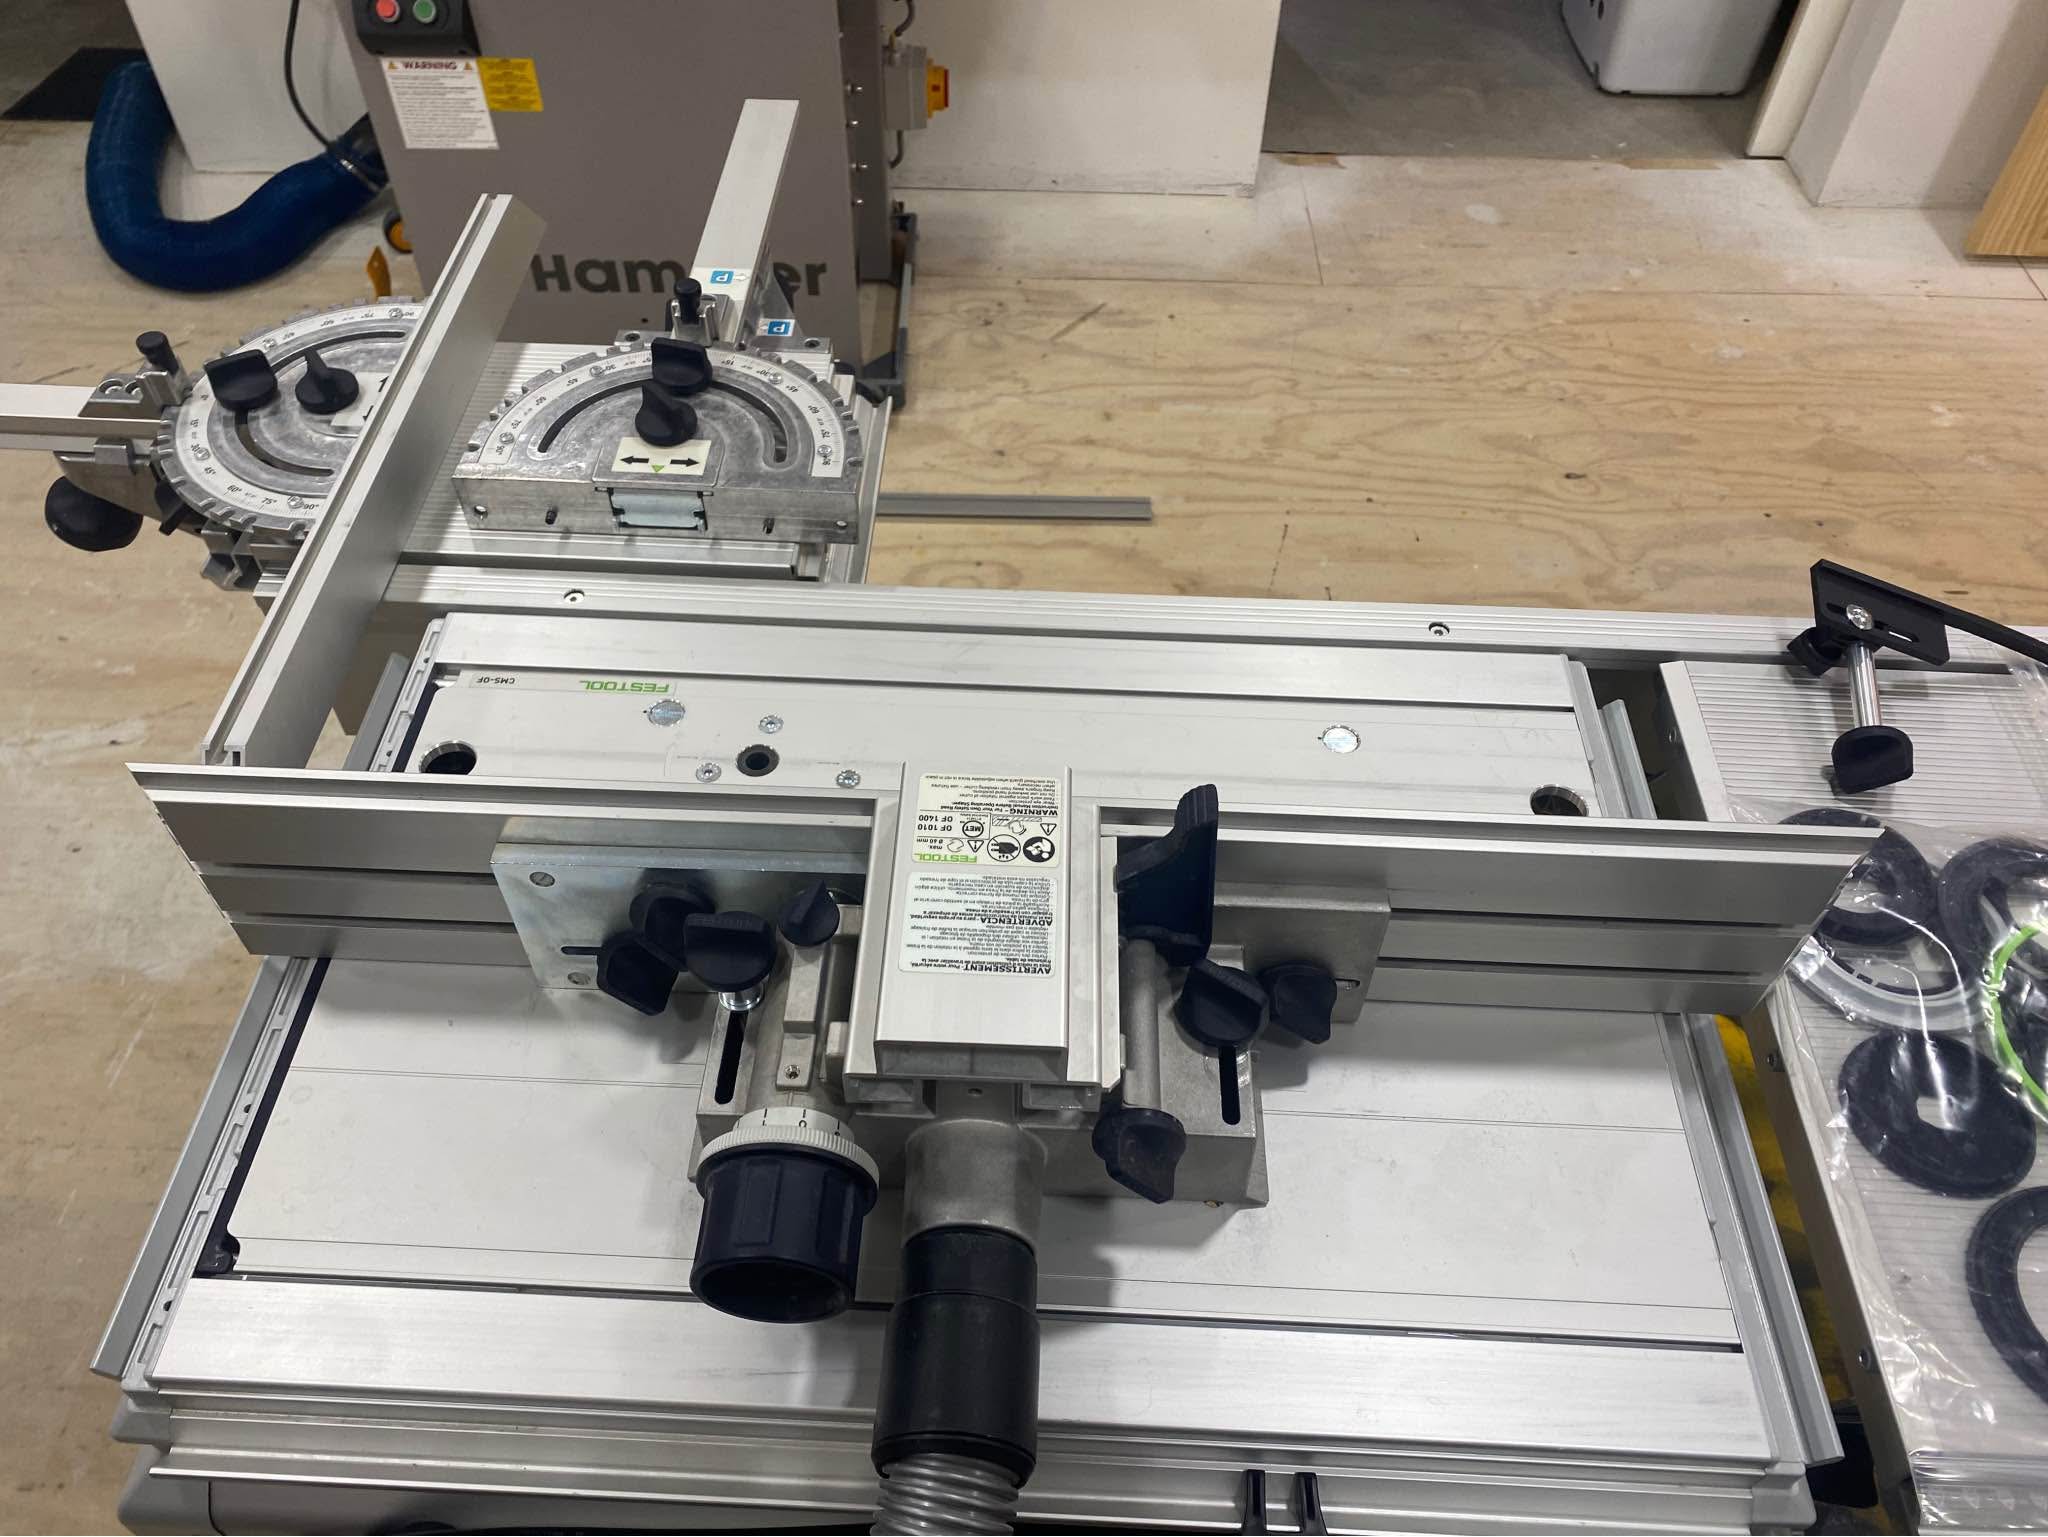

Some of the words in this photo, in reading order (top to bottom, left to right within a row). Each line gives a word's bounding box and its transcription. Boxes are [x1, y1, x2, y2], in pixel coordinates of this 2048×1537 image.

[530, 254, 827, 296] Hamer
[579, 680, 670, 693] FESTOOL
[1009, 808, 1058, 816] WARNING
[917, 823, 938, 831] 1010
[914, 853, 977, 863] FESTOOL
[981, 917, 1052, 926] ADVERTENCIA
[963, 963, 1051, 974] AVERTISSEMENT
